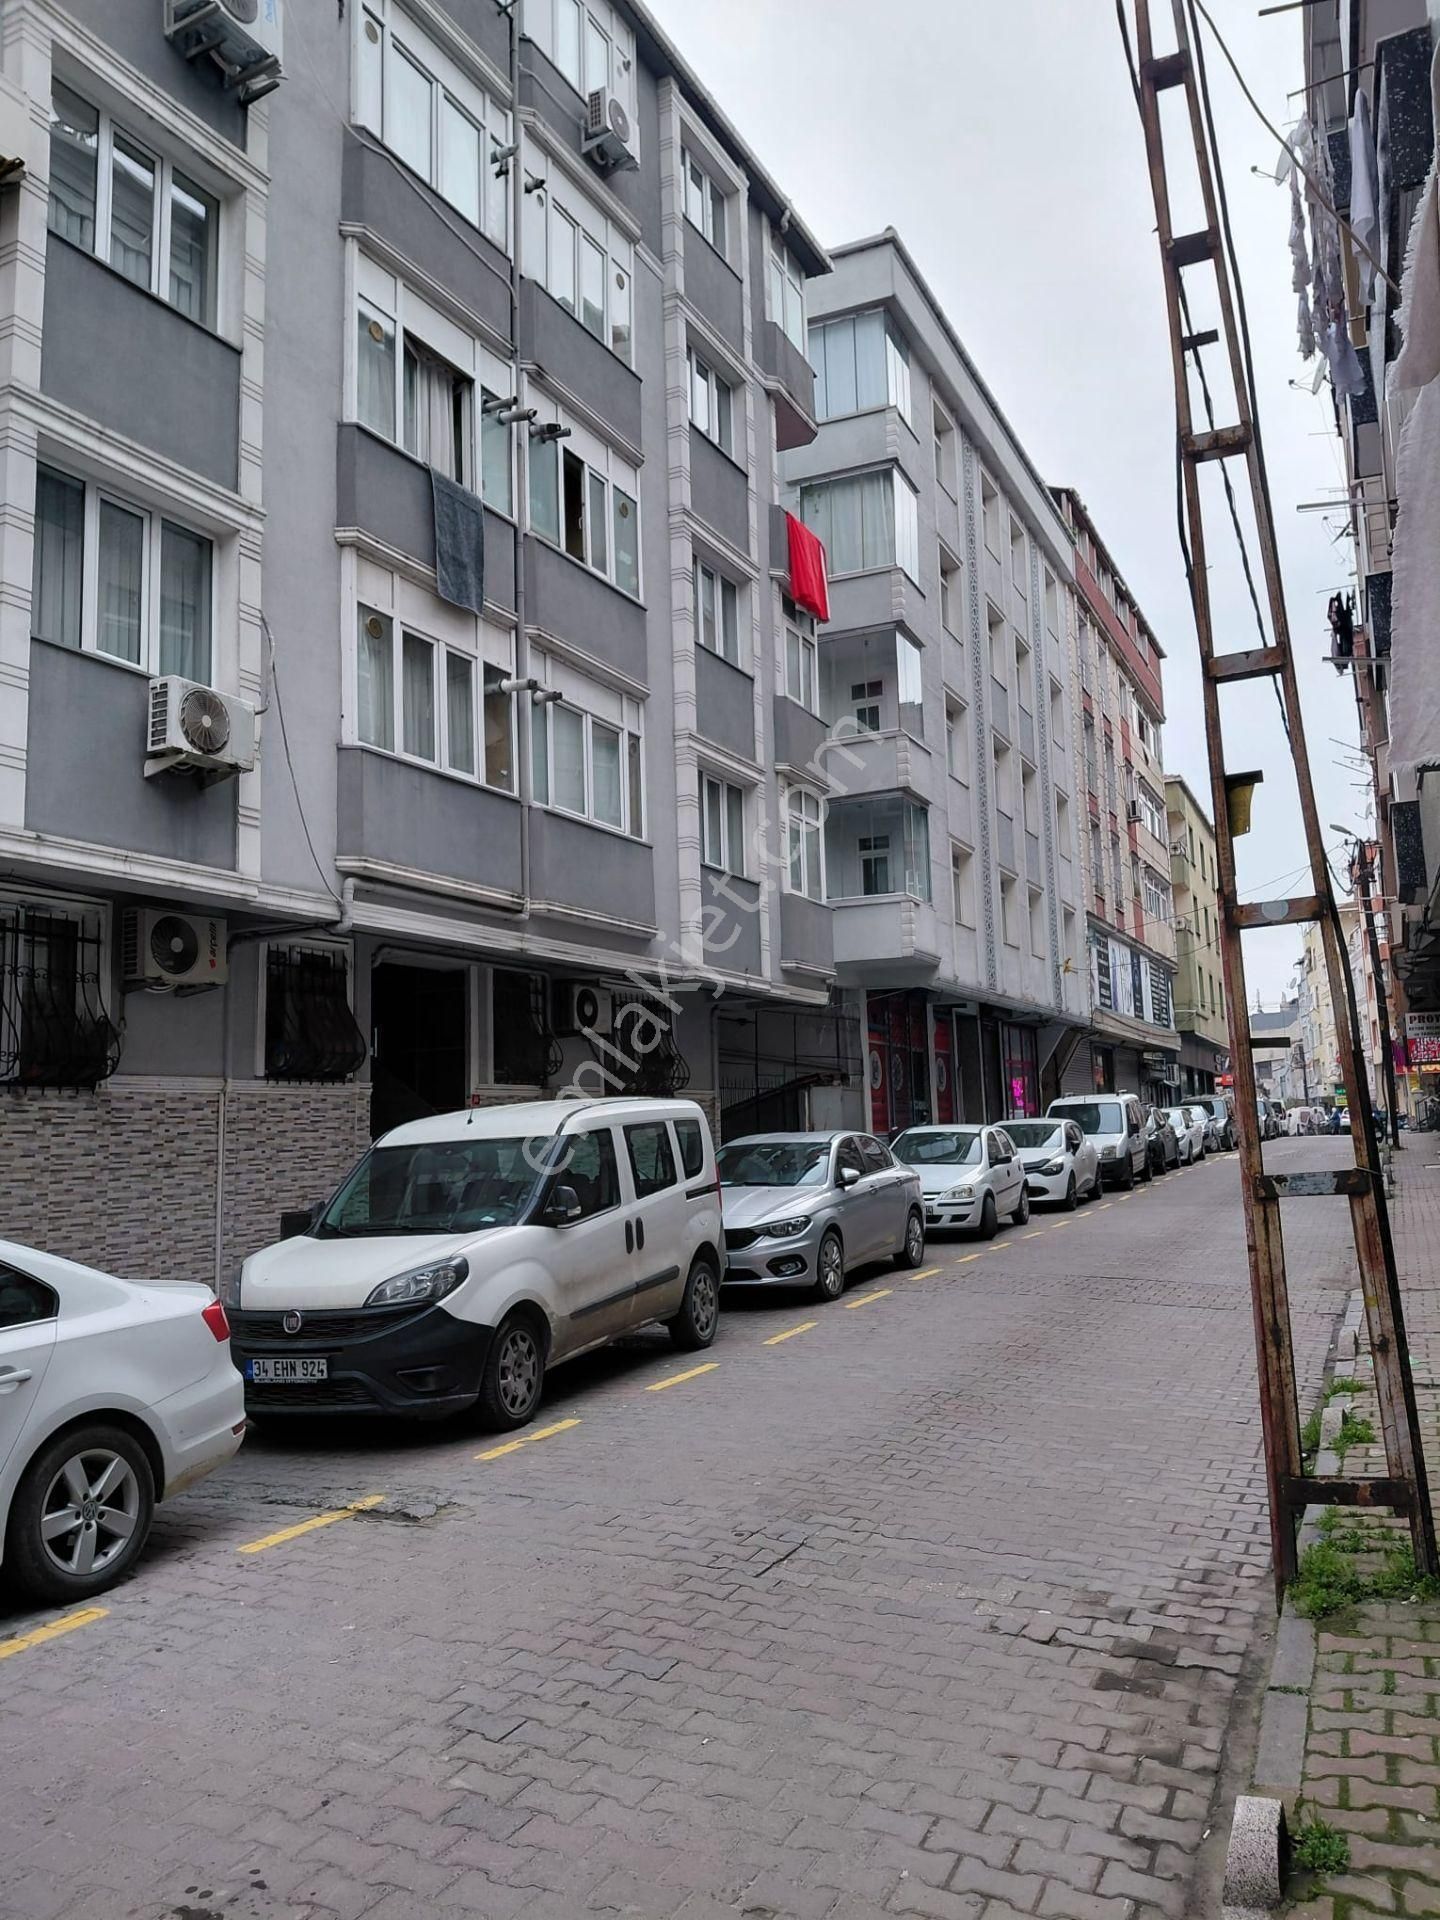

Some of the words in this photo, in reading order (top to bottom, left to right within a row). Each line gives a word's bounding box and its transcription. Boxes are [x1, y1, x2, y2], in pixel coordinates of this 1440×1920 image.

[254, 1361, 268, 1377] 34
[273, 1361, 297, 1377] EHN
[301, 1361, 325, 1377] 924
